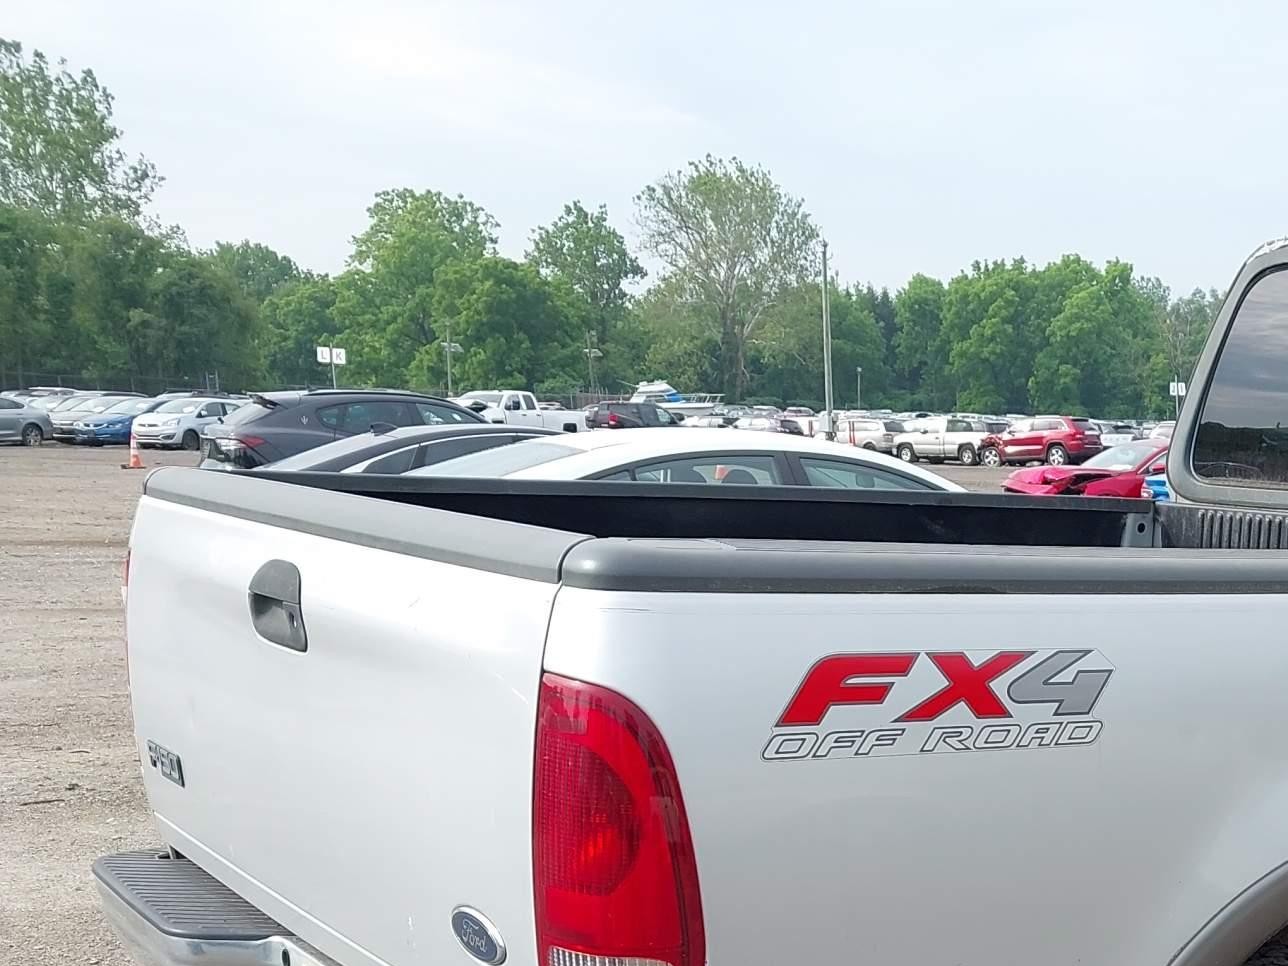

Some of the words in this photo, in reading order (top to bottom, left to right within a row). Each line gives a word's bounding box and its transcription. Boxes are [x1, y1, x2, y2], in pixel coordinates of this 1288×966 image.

[774, 650, 1114, 728] FX4
[761, 728, 906, 761] OFF
[920, 720, 1104, 753] ROAD
[461, 917, 488, 954] Ford
